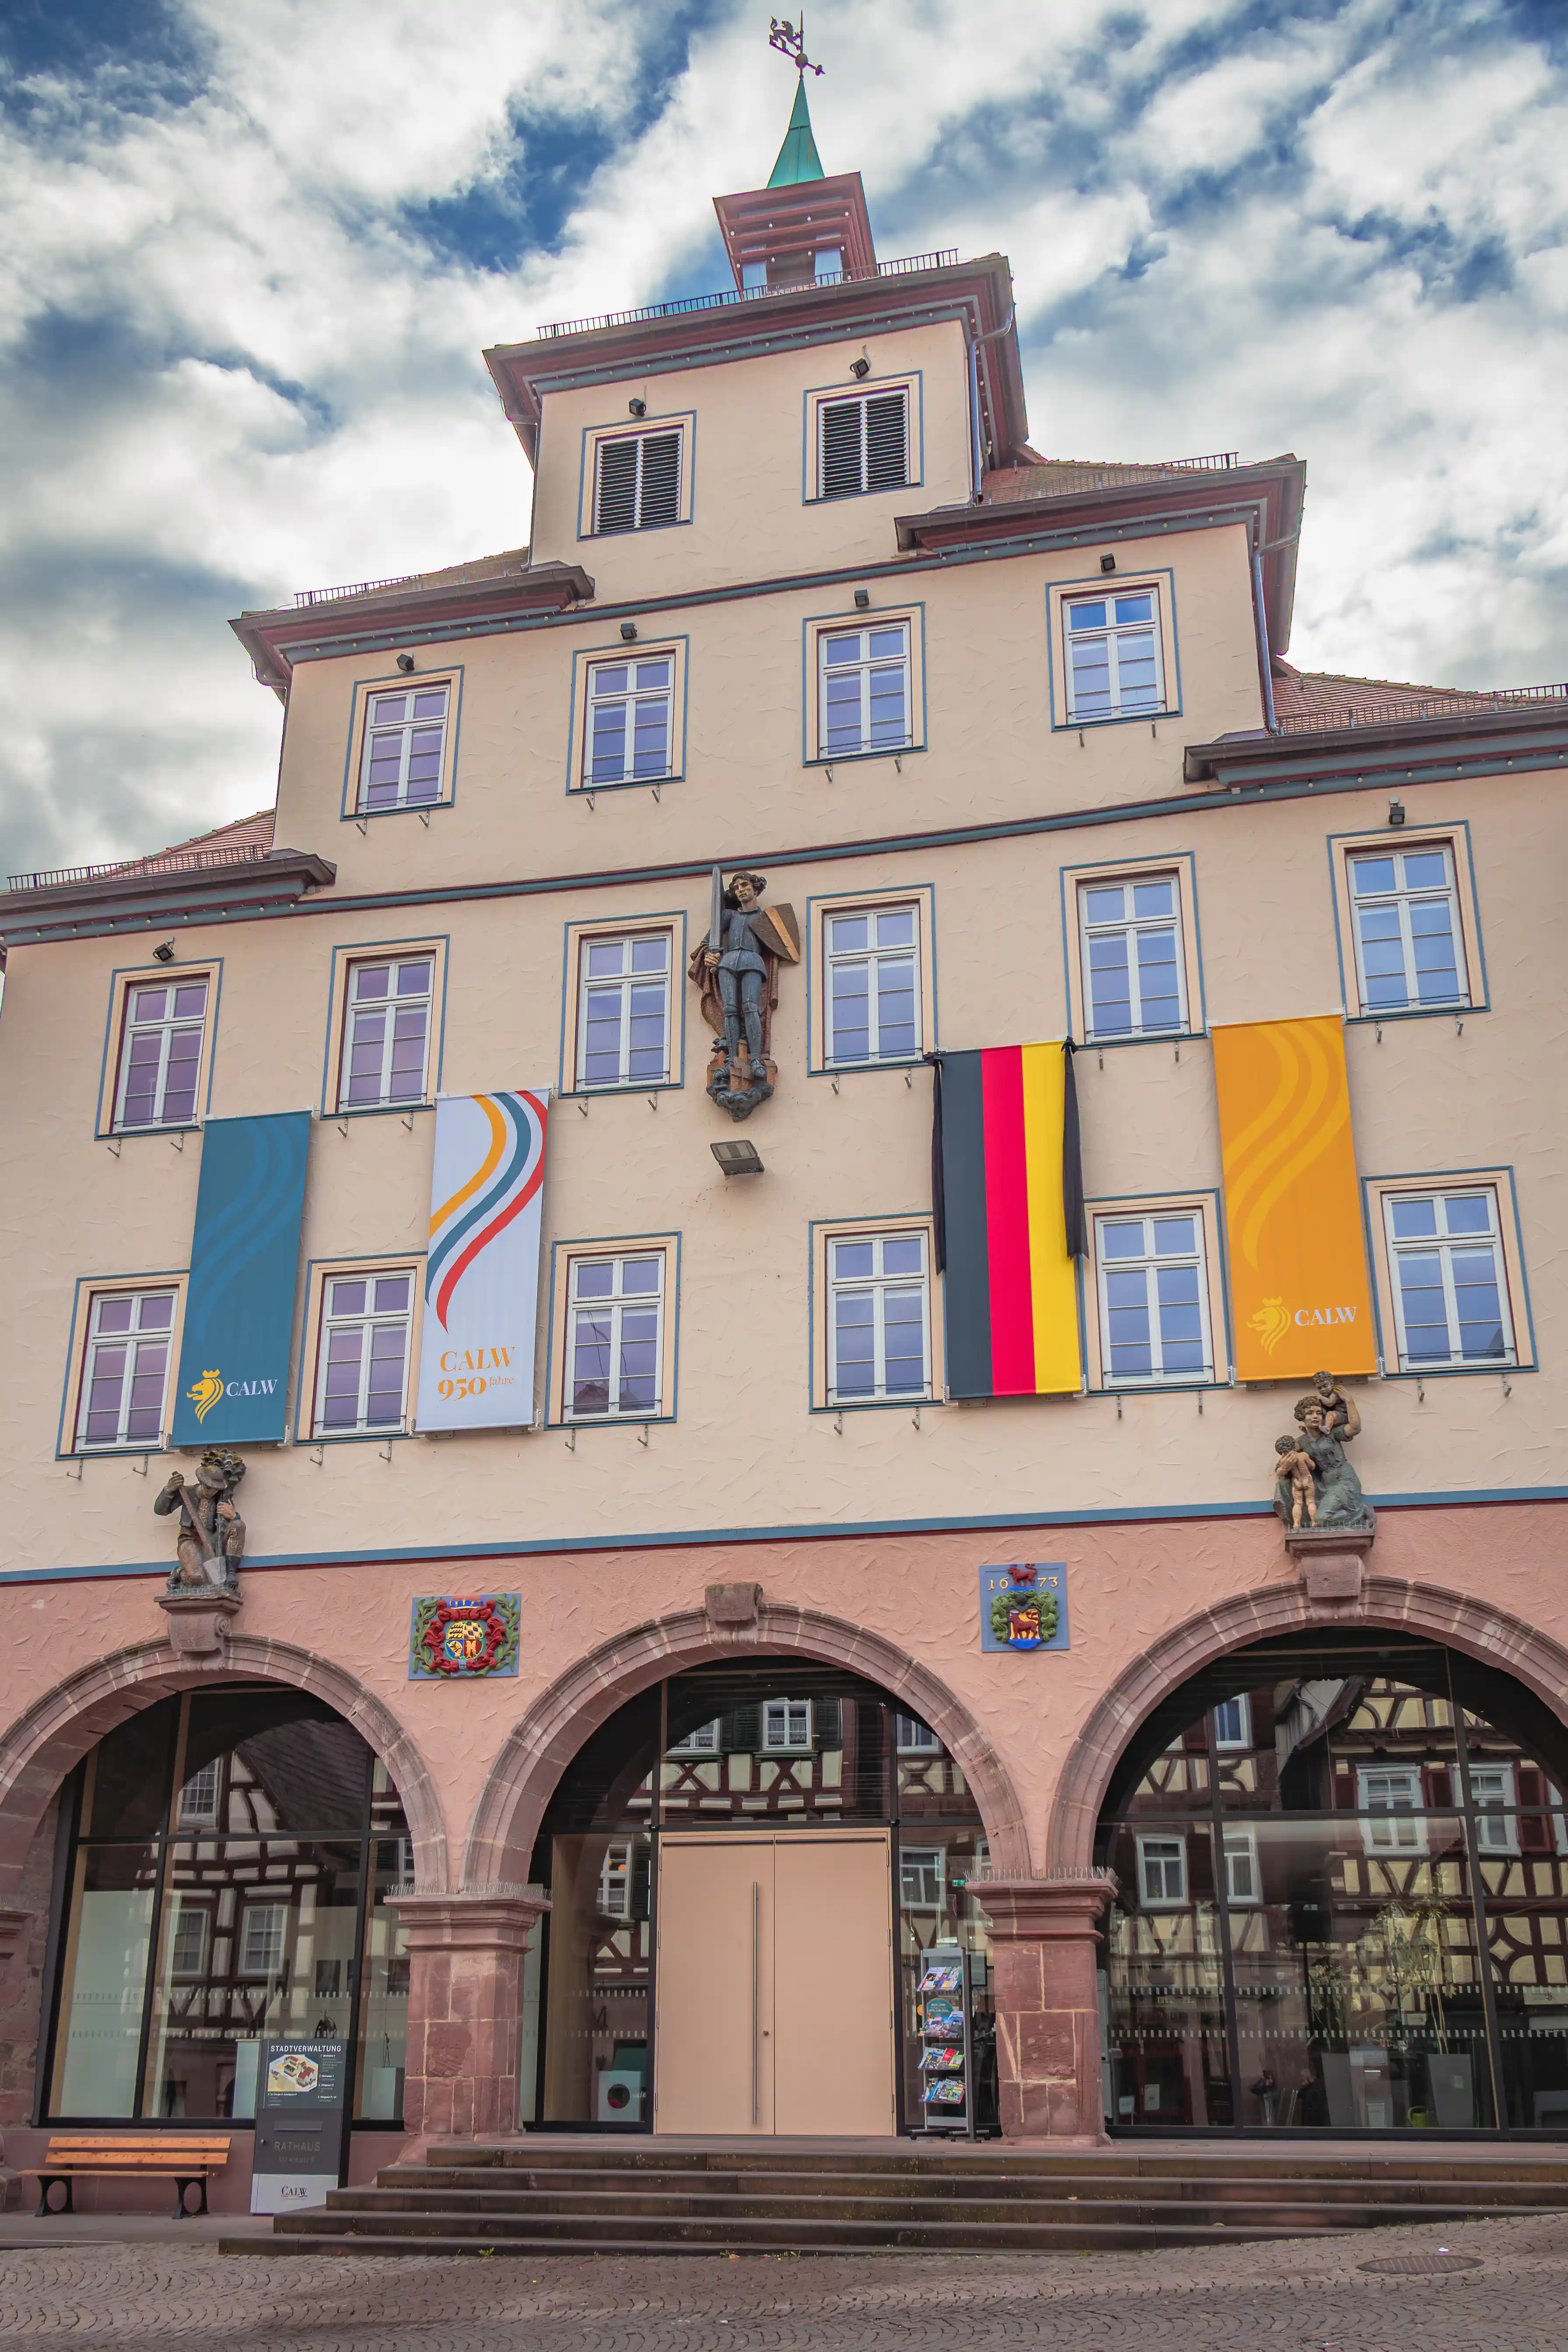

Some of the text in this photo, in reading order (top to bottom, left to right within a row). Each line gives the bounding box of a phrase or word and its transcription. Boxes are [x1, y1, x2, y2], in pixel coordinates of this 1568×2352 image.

[1294, 1306, 1358, 1326] CALW
[440, 1347, 516, 1371] CALW
[226, 1379, 278, 1397] CALW
[438, 1376, 515, 1402] 950 Jahre
[274, 2141, 321, 2152] RATHAUS
[281, 2186, 307, 2196] CALW
